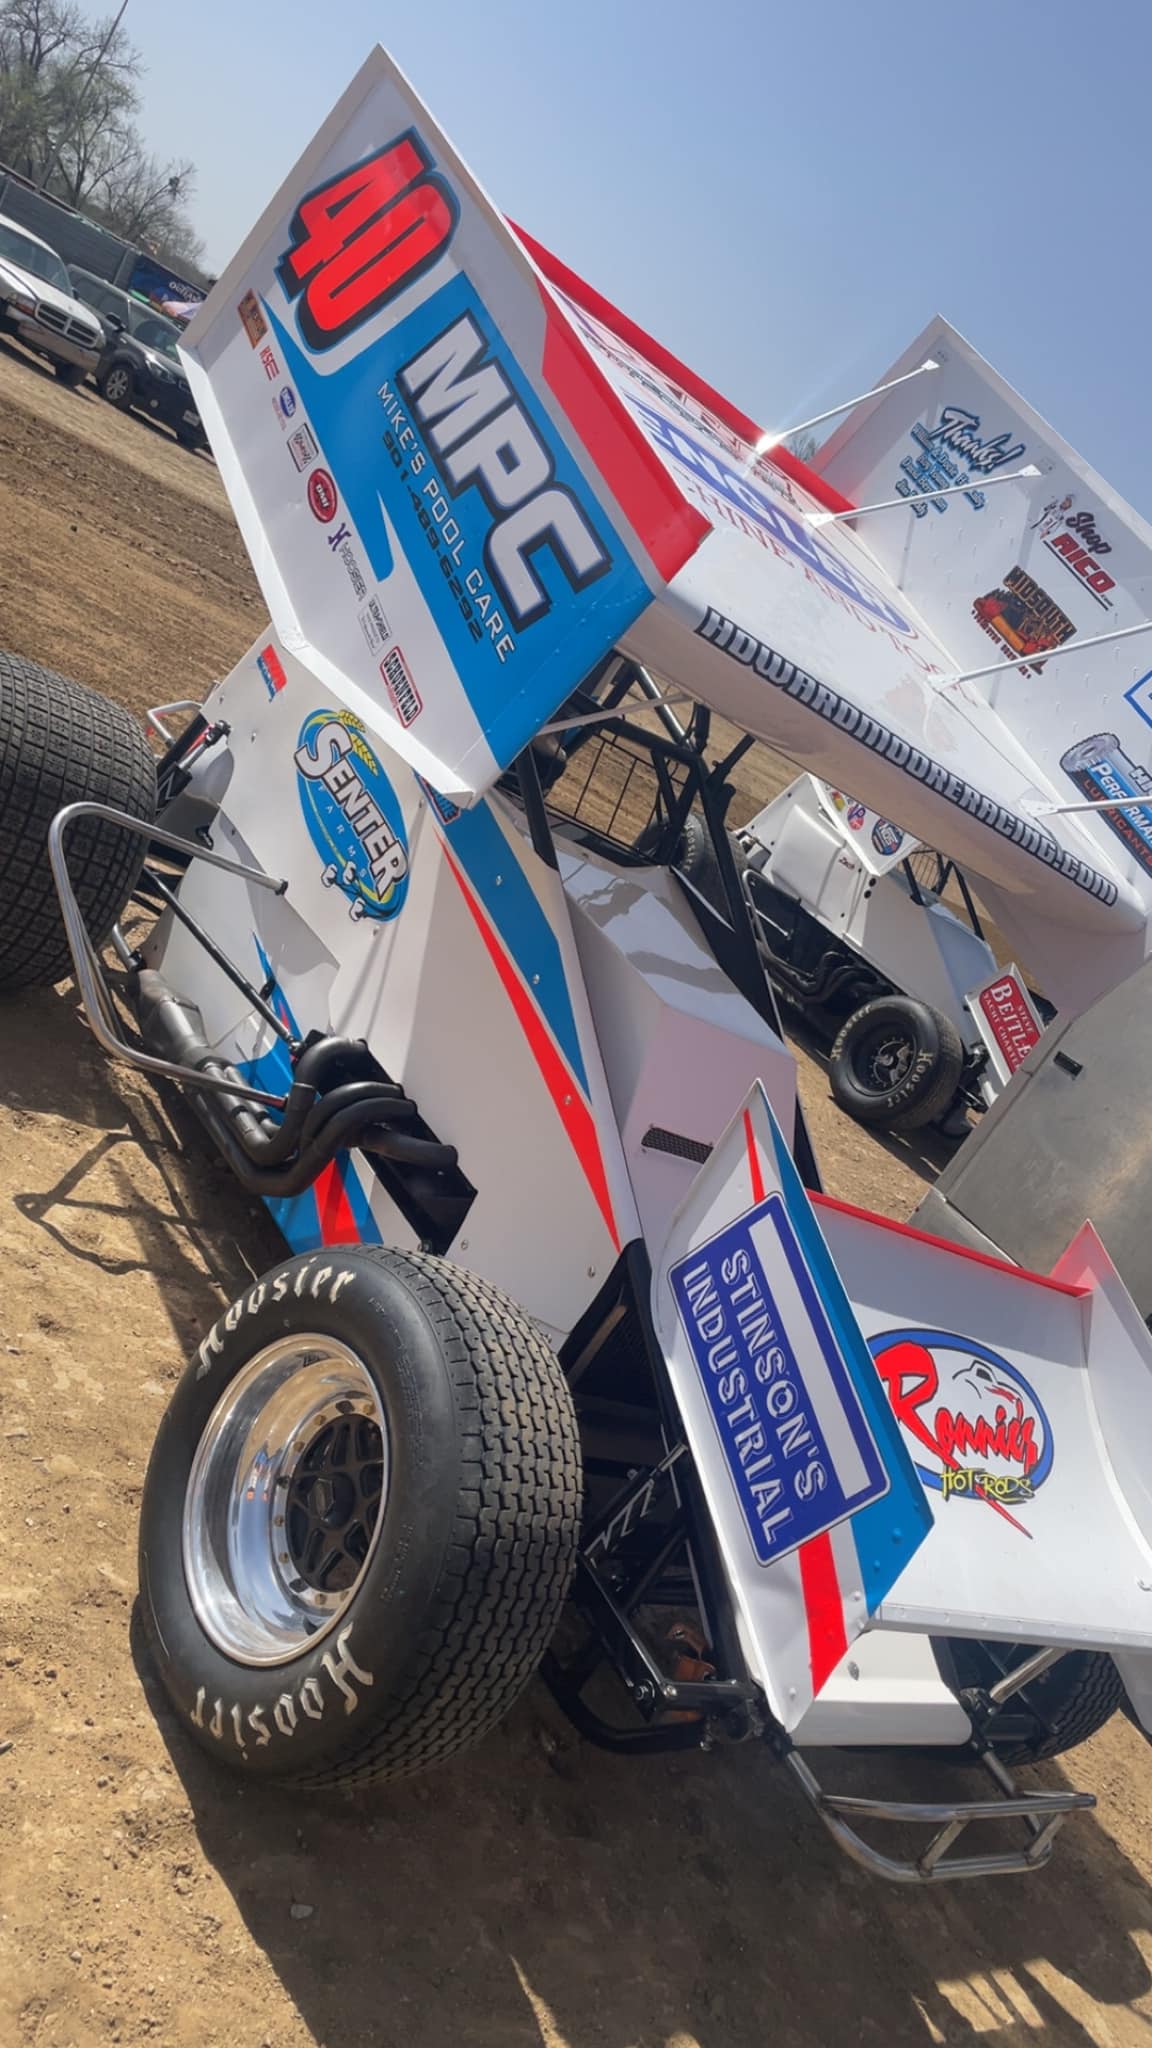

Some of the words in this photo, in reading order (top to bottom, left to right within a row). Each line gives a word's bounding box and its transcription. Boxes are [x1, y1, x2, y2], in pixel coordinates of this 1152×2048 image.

[278, 128, 460, 352] 40
[398, 310, 612, 632] MPC
[930, 407, 1026, 474] Thanks!
[377, 381, 426, 476] MIKE'S
[423, 478, 467, 567] POOL
[465, 567, 516, 664] CARE
[1065, 511, 1113, 555] Shop
[1002, 565, 1078, 646] MIDSOUTH
[383, 651, 419, 722] SCHOENFELD
[294, 721, 408, 901] SENTER
[318, 785, 368, 879] FARMS
[1090, 760, 1152, 844] PERFRMA
[991, 983, 1034, 1059] BEITLE
[999, 1025, 1023, 1069] CHARTE
[196, 1256, 357, 1382] Hoosier
[682, 1261, 795, 1546] INDUSTRIAL
[719, 1248, 828, 1502] STINSON'S
[189, 1622, 374, 1760] Hoosier
